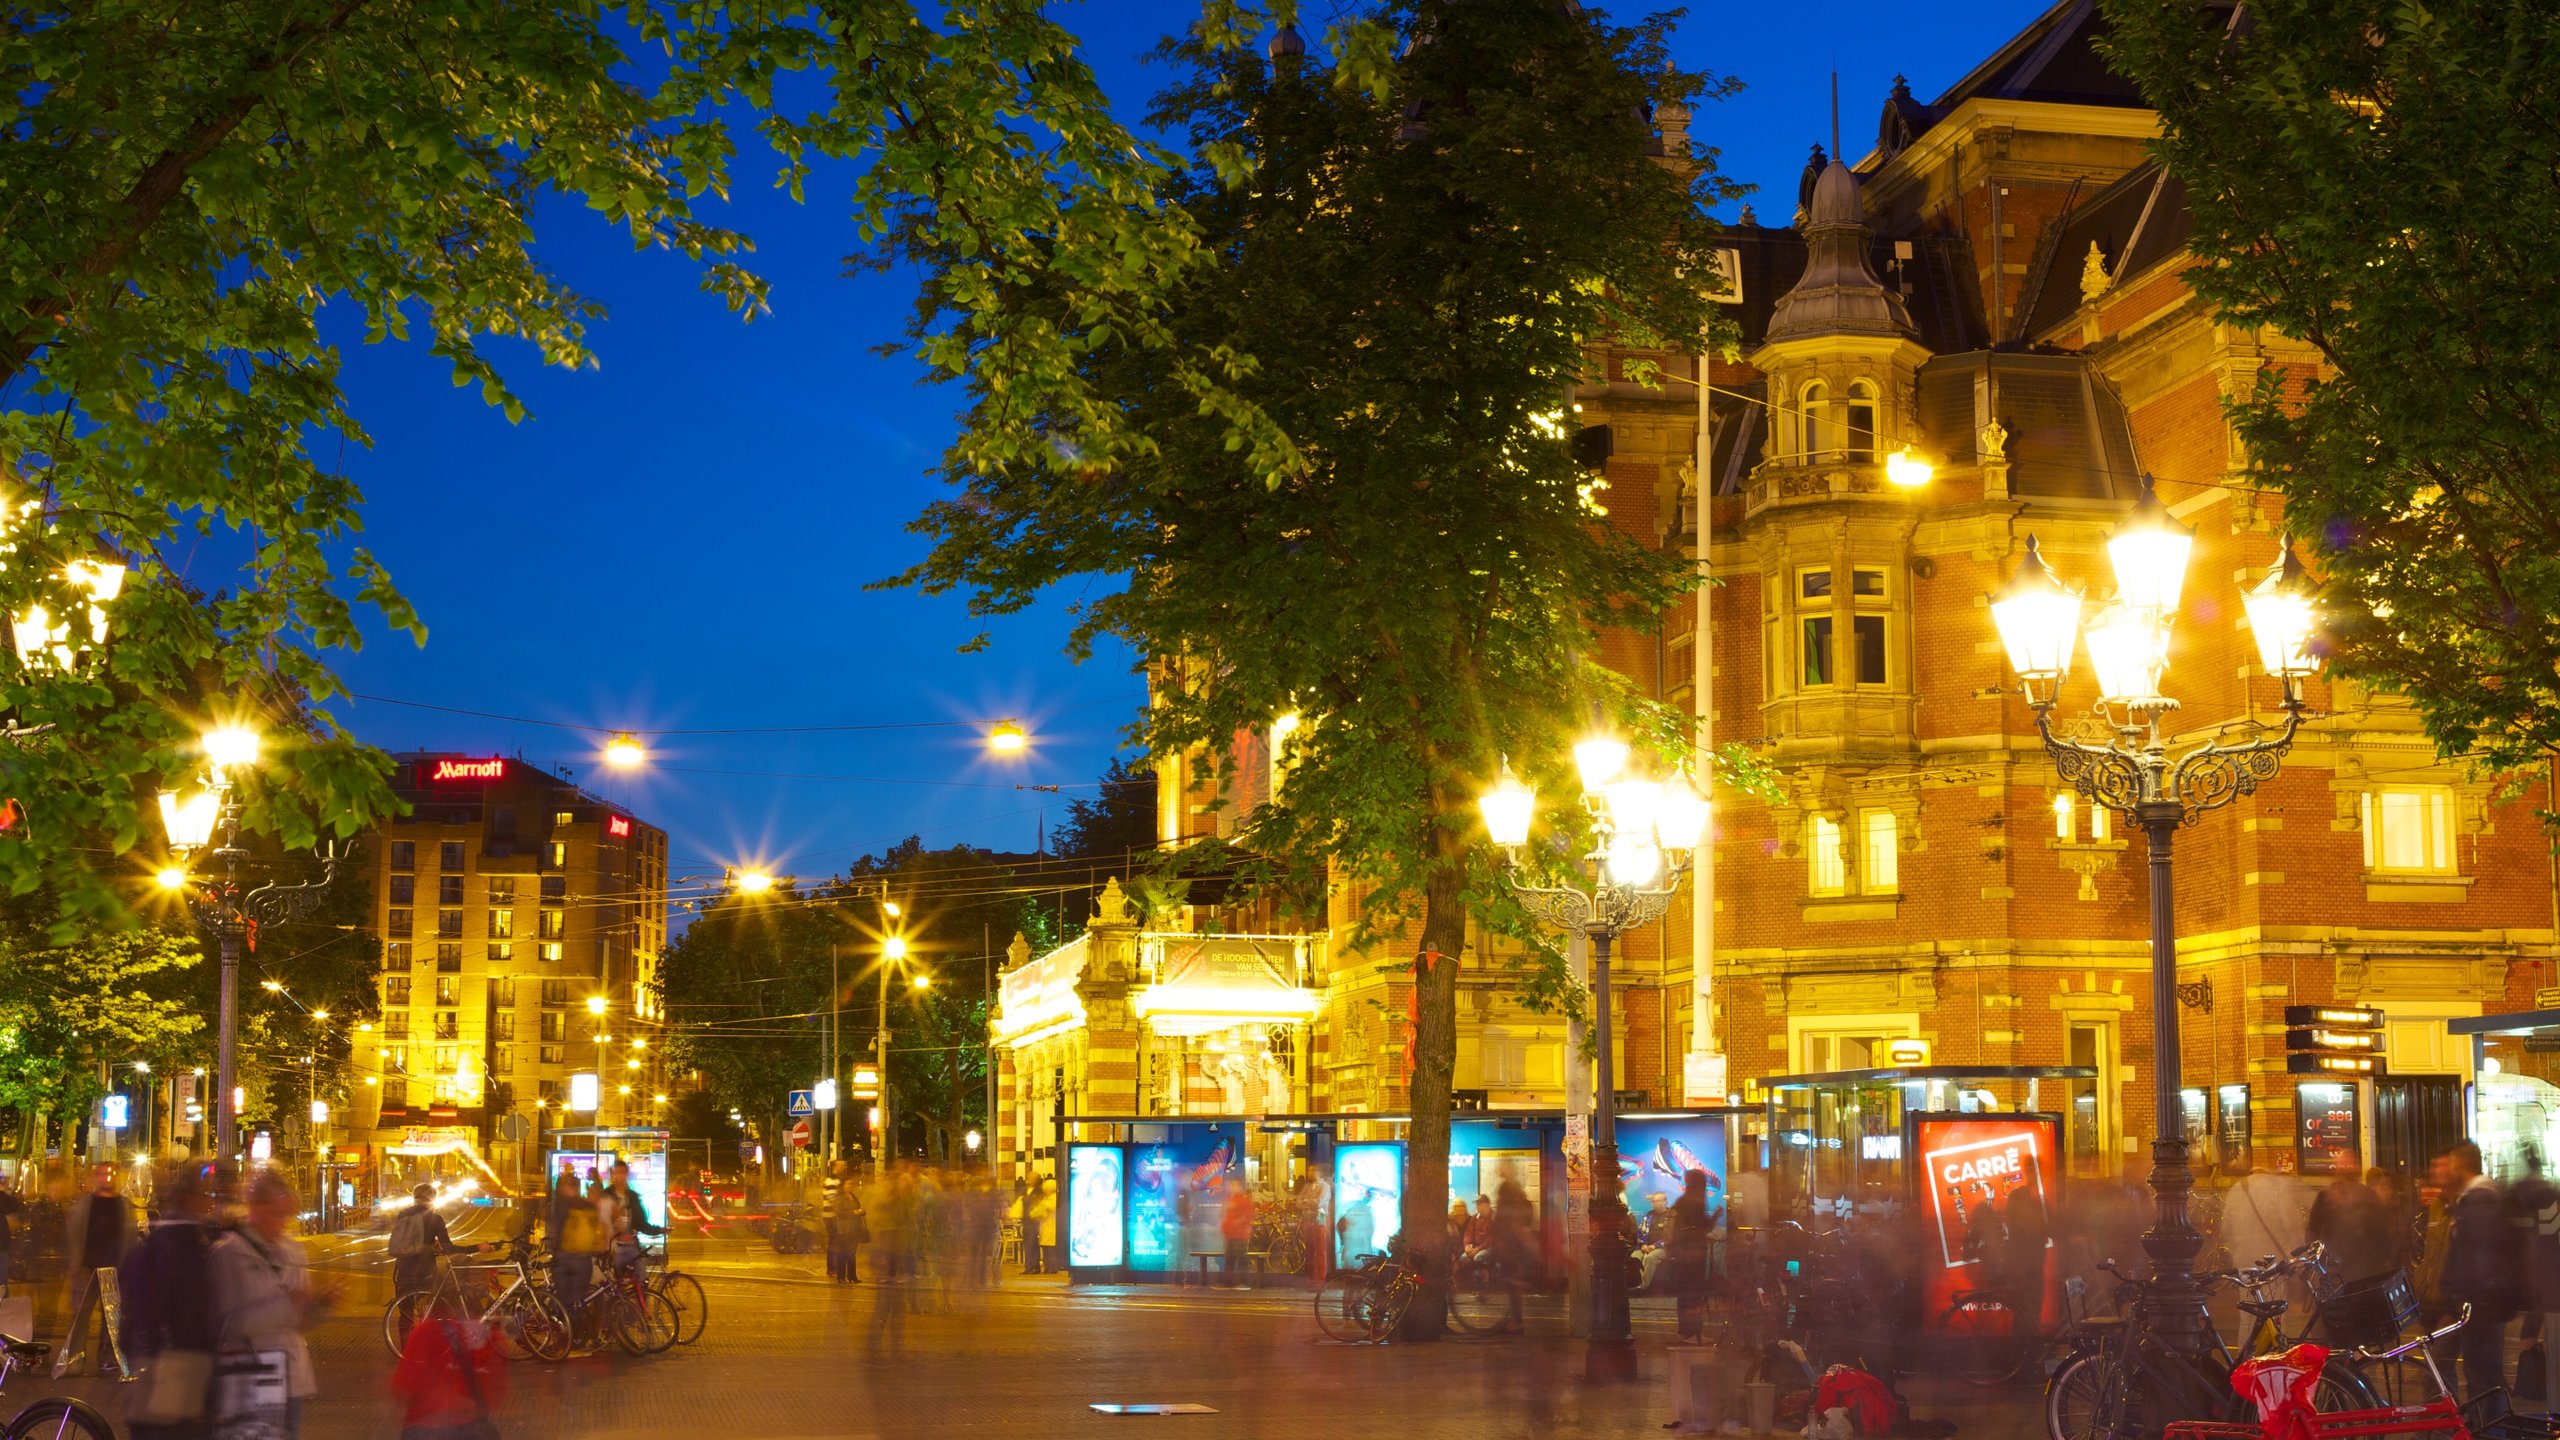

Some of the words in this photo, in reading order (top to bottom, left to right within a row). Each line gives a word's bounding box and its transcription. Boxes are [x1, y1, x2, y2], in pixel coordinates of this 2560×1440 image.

[433, 760, 503, 780] Marriott
[1212, 953, 1222, 962] DE
[1236, 962, 1252, 971] VAN
[1253, 963, 1285, 973] SEIEN
[2327, 1110, 2352, 1122] see
[2306, 1118, 2323, 1130] or
